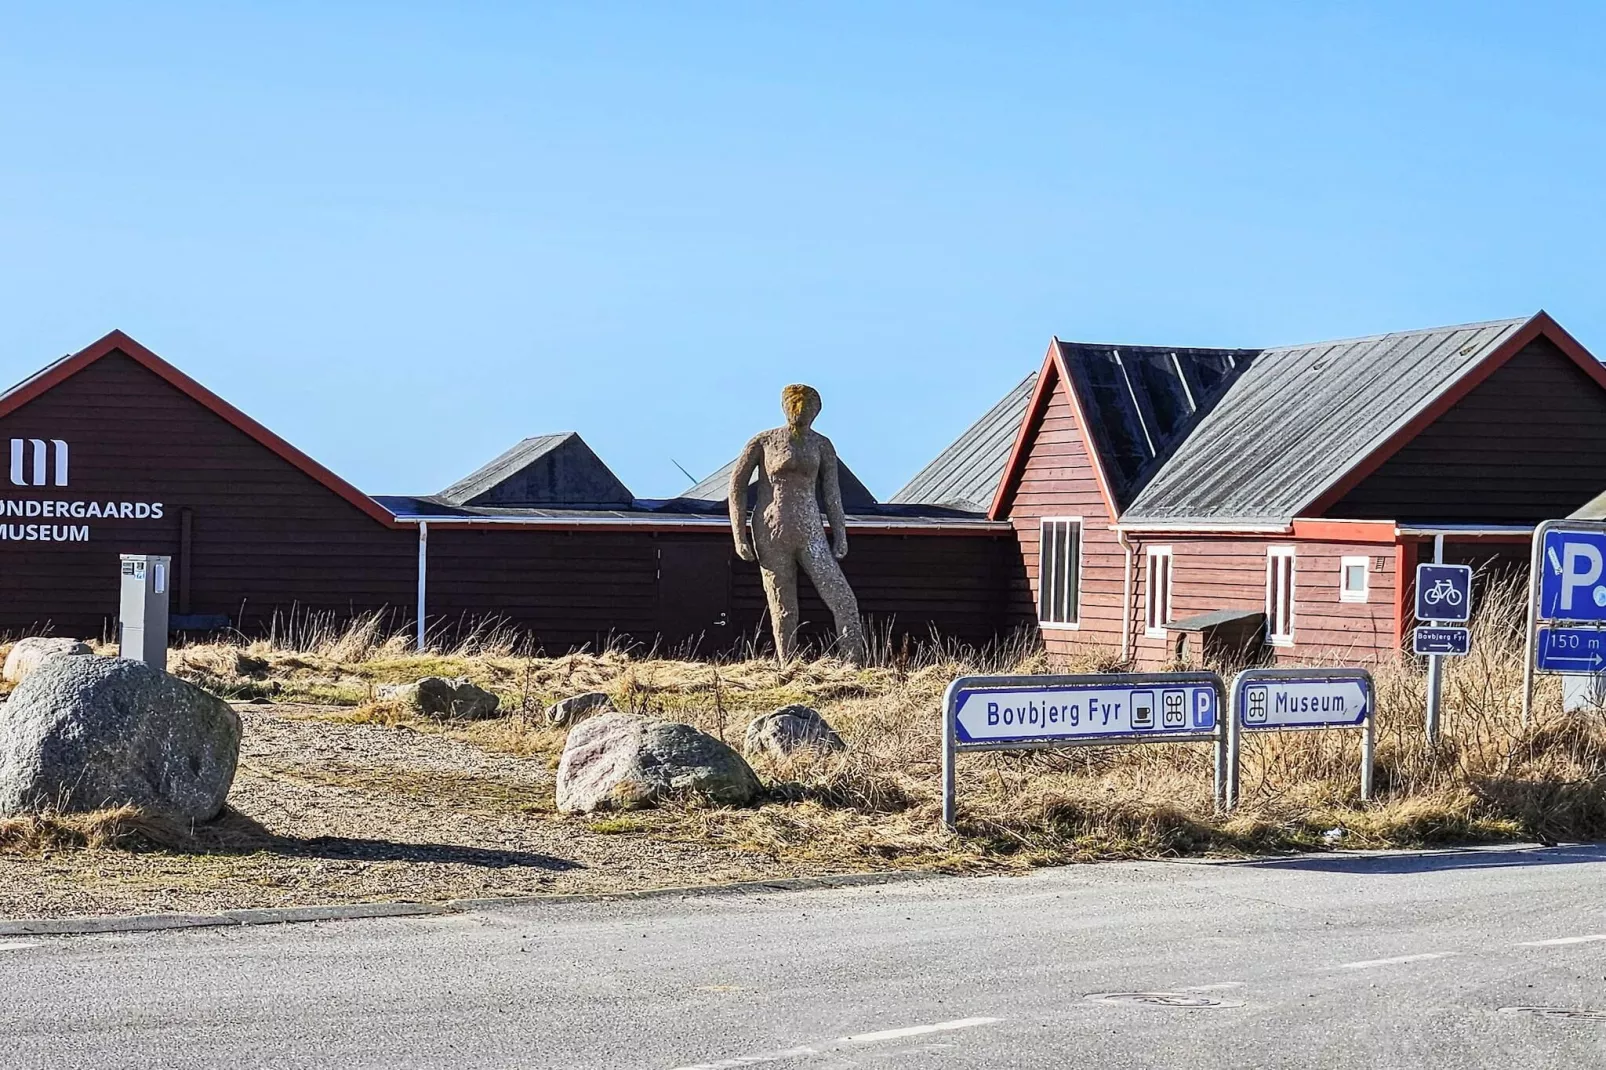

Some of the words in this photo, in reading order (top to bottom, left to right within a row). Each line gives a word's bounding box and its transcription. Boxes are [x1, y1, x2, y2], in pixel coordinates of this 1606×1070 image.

[1560, 542, 1604, 610] P
[1417, 632, 1451, 641] Bovbjerg
[1453, 633, 1466, 642] Fyr
[1551, 634, 1580, 649] 150
[1588, 639, 1600, 649] m
[987, 701, 1080, 728] Bovbjerg
[1088, 698, 1122, 725] Fyr
[1197, 692, 1210, 723] P
[1275, 691, 1345, 713] Museum
